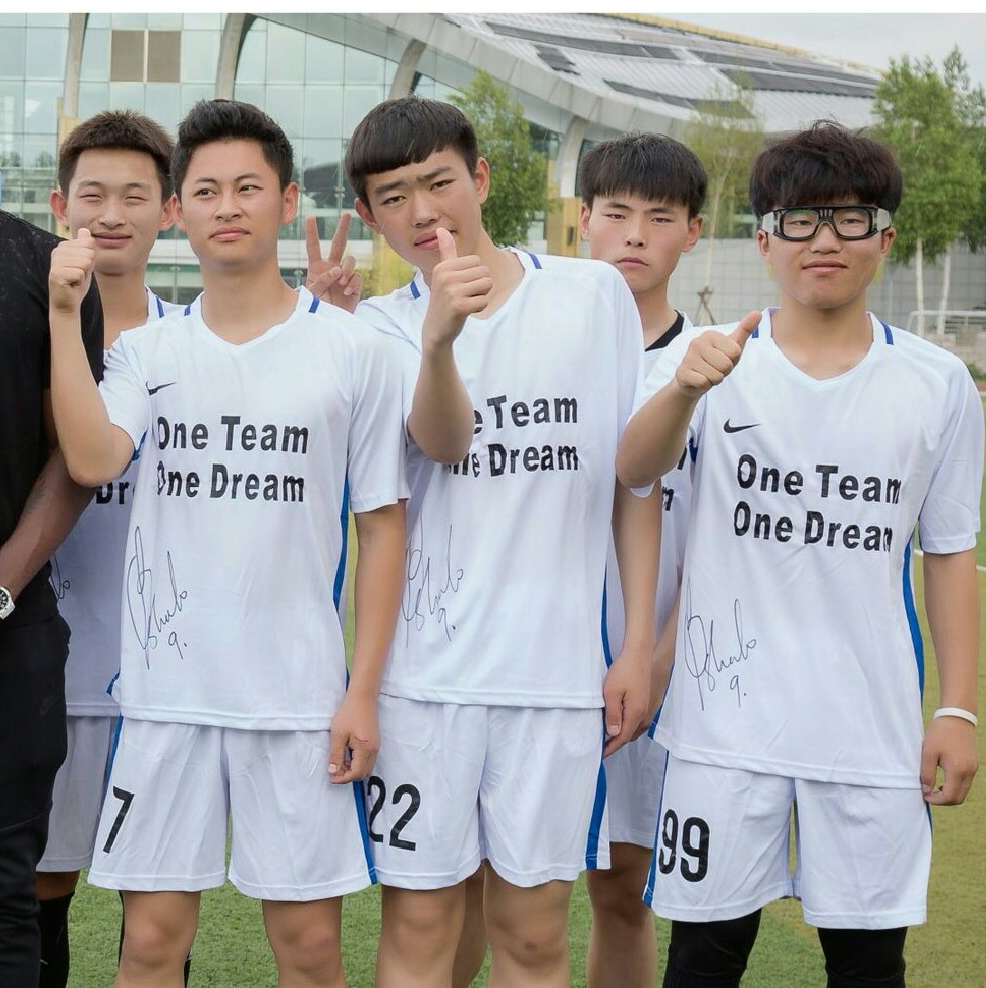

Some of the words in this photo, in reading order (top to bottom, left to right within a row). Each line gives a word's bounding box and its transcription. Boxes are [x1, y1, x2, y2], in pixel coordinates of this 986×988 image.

[156, 416, 209, 450] One
[220, 415, 309, 454] Team
[486, 394, 578, 429] Team
[156, 460, 200, 497] One
[209, 462, 305, 502] Dream
[487, 443, 579, 477] Dream
[736, 453, 804, 496] One
[815, 464, 902, 504] Team
[733, 500, 793, 543] One
[804, 510, 893, 552] Dream
[103, 786, 135, 854] 7
[367, 775, 421, 852] 22
[658, 808, 710, 883] 99
